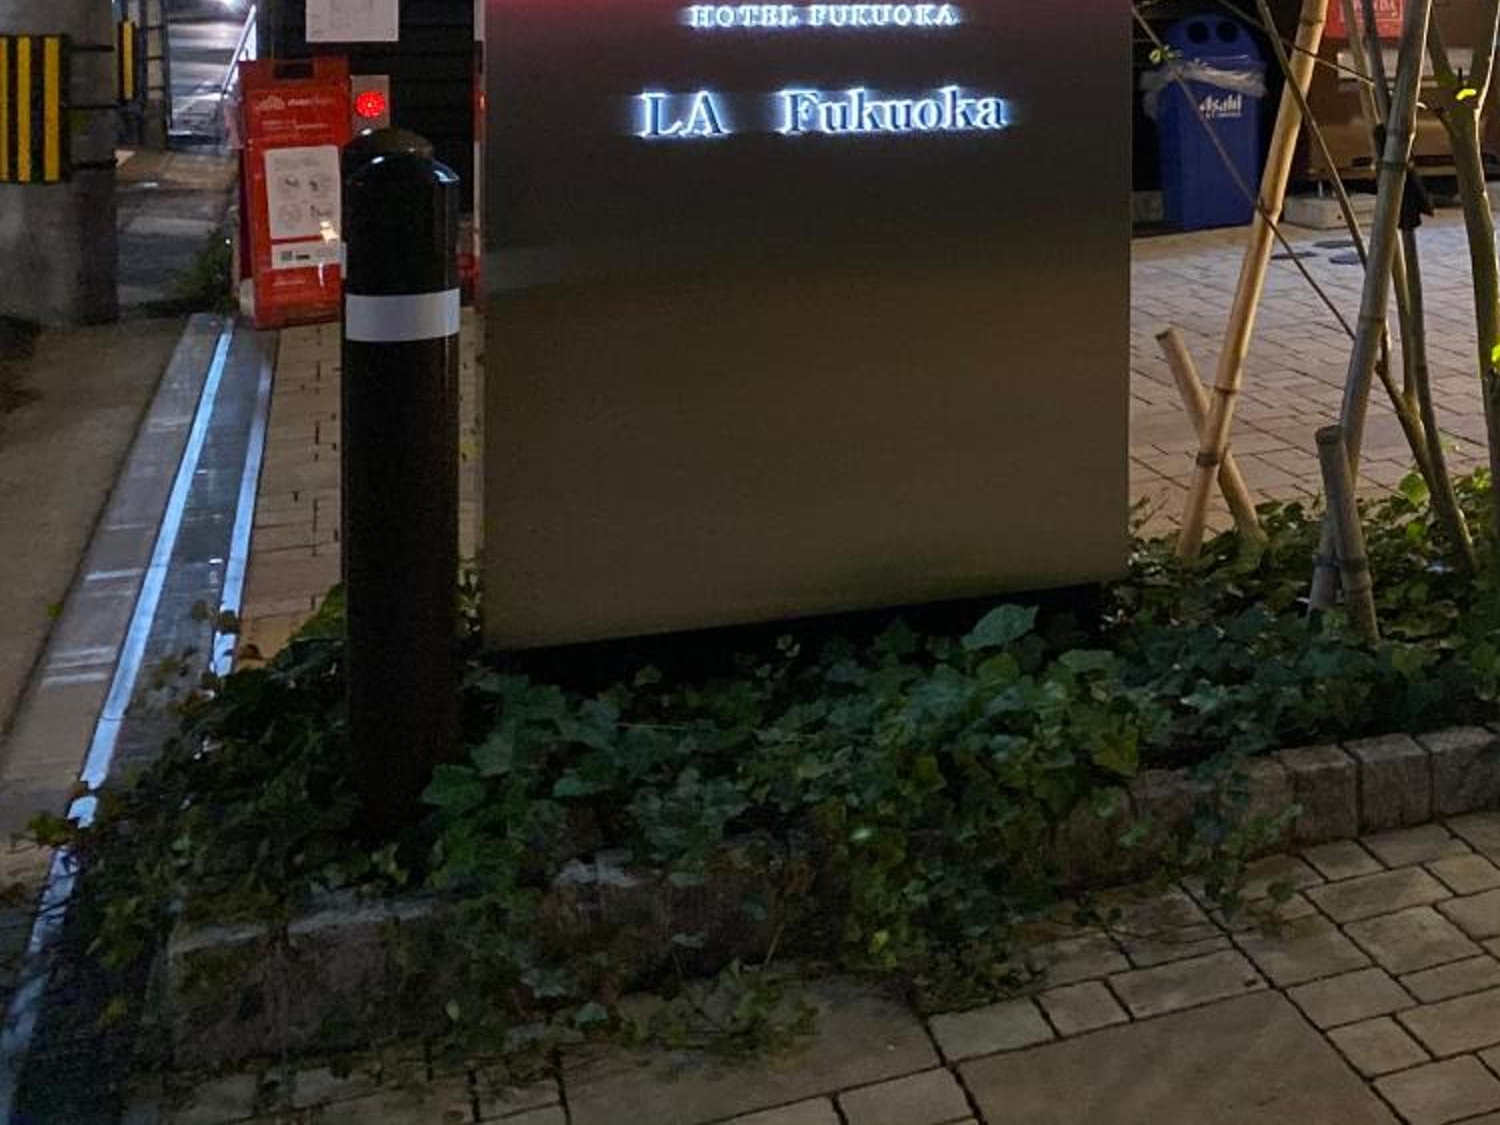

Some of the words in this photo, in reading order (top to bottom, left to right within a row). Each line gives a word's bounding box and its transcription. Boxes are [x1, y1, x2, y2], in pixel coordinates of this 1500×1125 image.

[688, 4, 799, 28] HOTEL
[808, 4, 960, 27] FUKUOKA
[637, 89, 733, 139] LA
[779, 85, 1010, 135] Fukuoka
